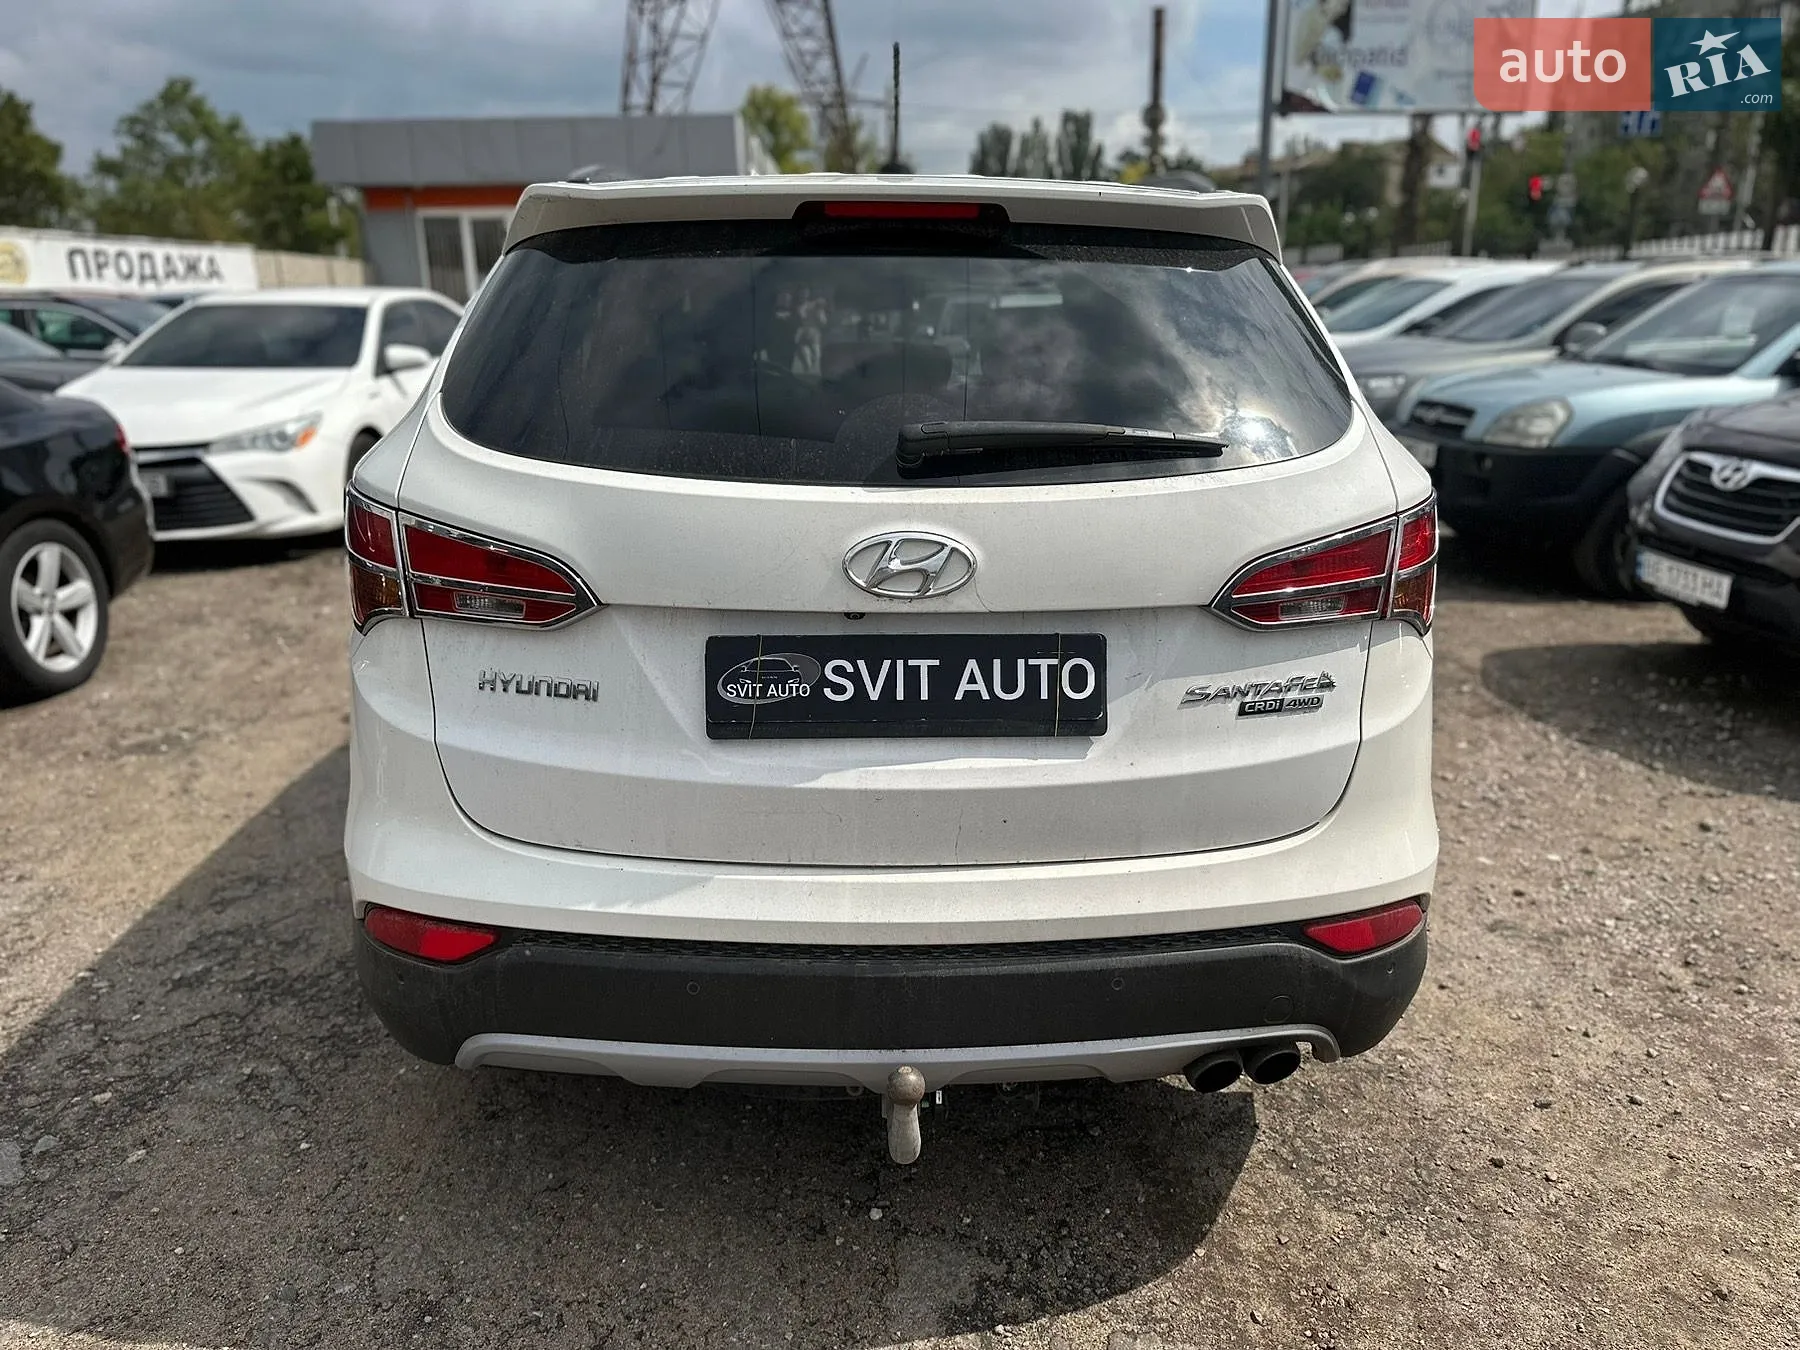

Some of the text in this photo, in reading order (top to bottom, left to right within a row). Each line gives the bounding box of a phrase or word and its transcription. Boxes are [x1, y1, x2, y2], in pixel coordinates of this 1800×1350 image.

[67, 247, 223, 286] ПРОДАЖА
[478, 668, 600, 702] HYUNDAI
[726, 684, 810, 697] SVIT AUTO
[823, 657, 1096, 702] SVIT AUTO
[1244, 696, 1322, 713] CRDi 4WD
